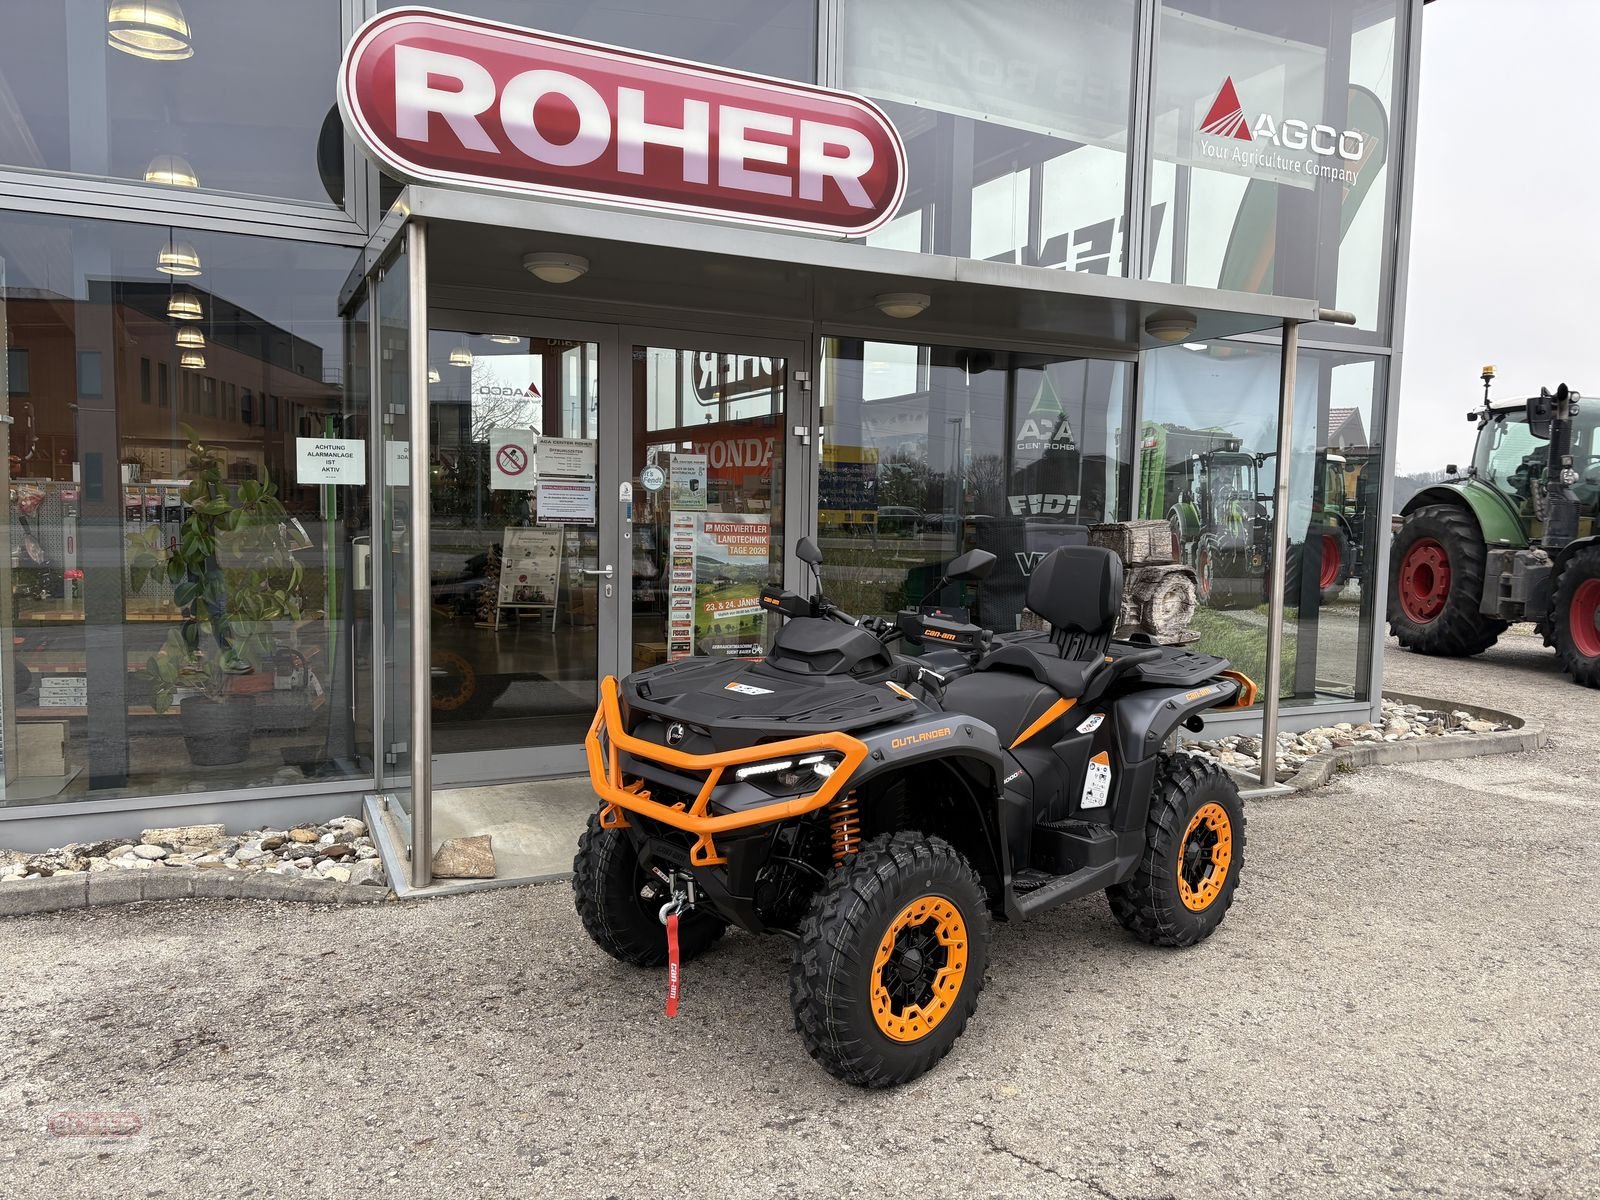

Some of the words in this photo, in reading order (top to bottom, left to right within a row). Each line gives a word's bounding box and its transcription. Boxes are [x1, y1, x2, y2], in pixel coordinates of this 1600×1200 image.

[394, 43, 876, 210] ROHER
[1252, 113, 1364, 161] AGCO
[1200, 139, 1228, 157] Your
[1231, 146, 1300, 171] Agriculture
[1305, 159, 1359, 185] Company
[714, 524, 767, 533] MOSTVIERTLER
[718, 535, 767, 544] LANDTECHNIK
[705, 603, 717, 611] 23.
[738, 597, 759, 607] JÄNNE
[924, 628, 956, 641] can-am
